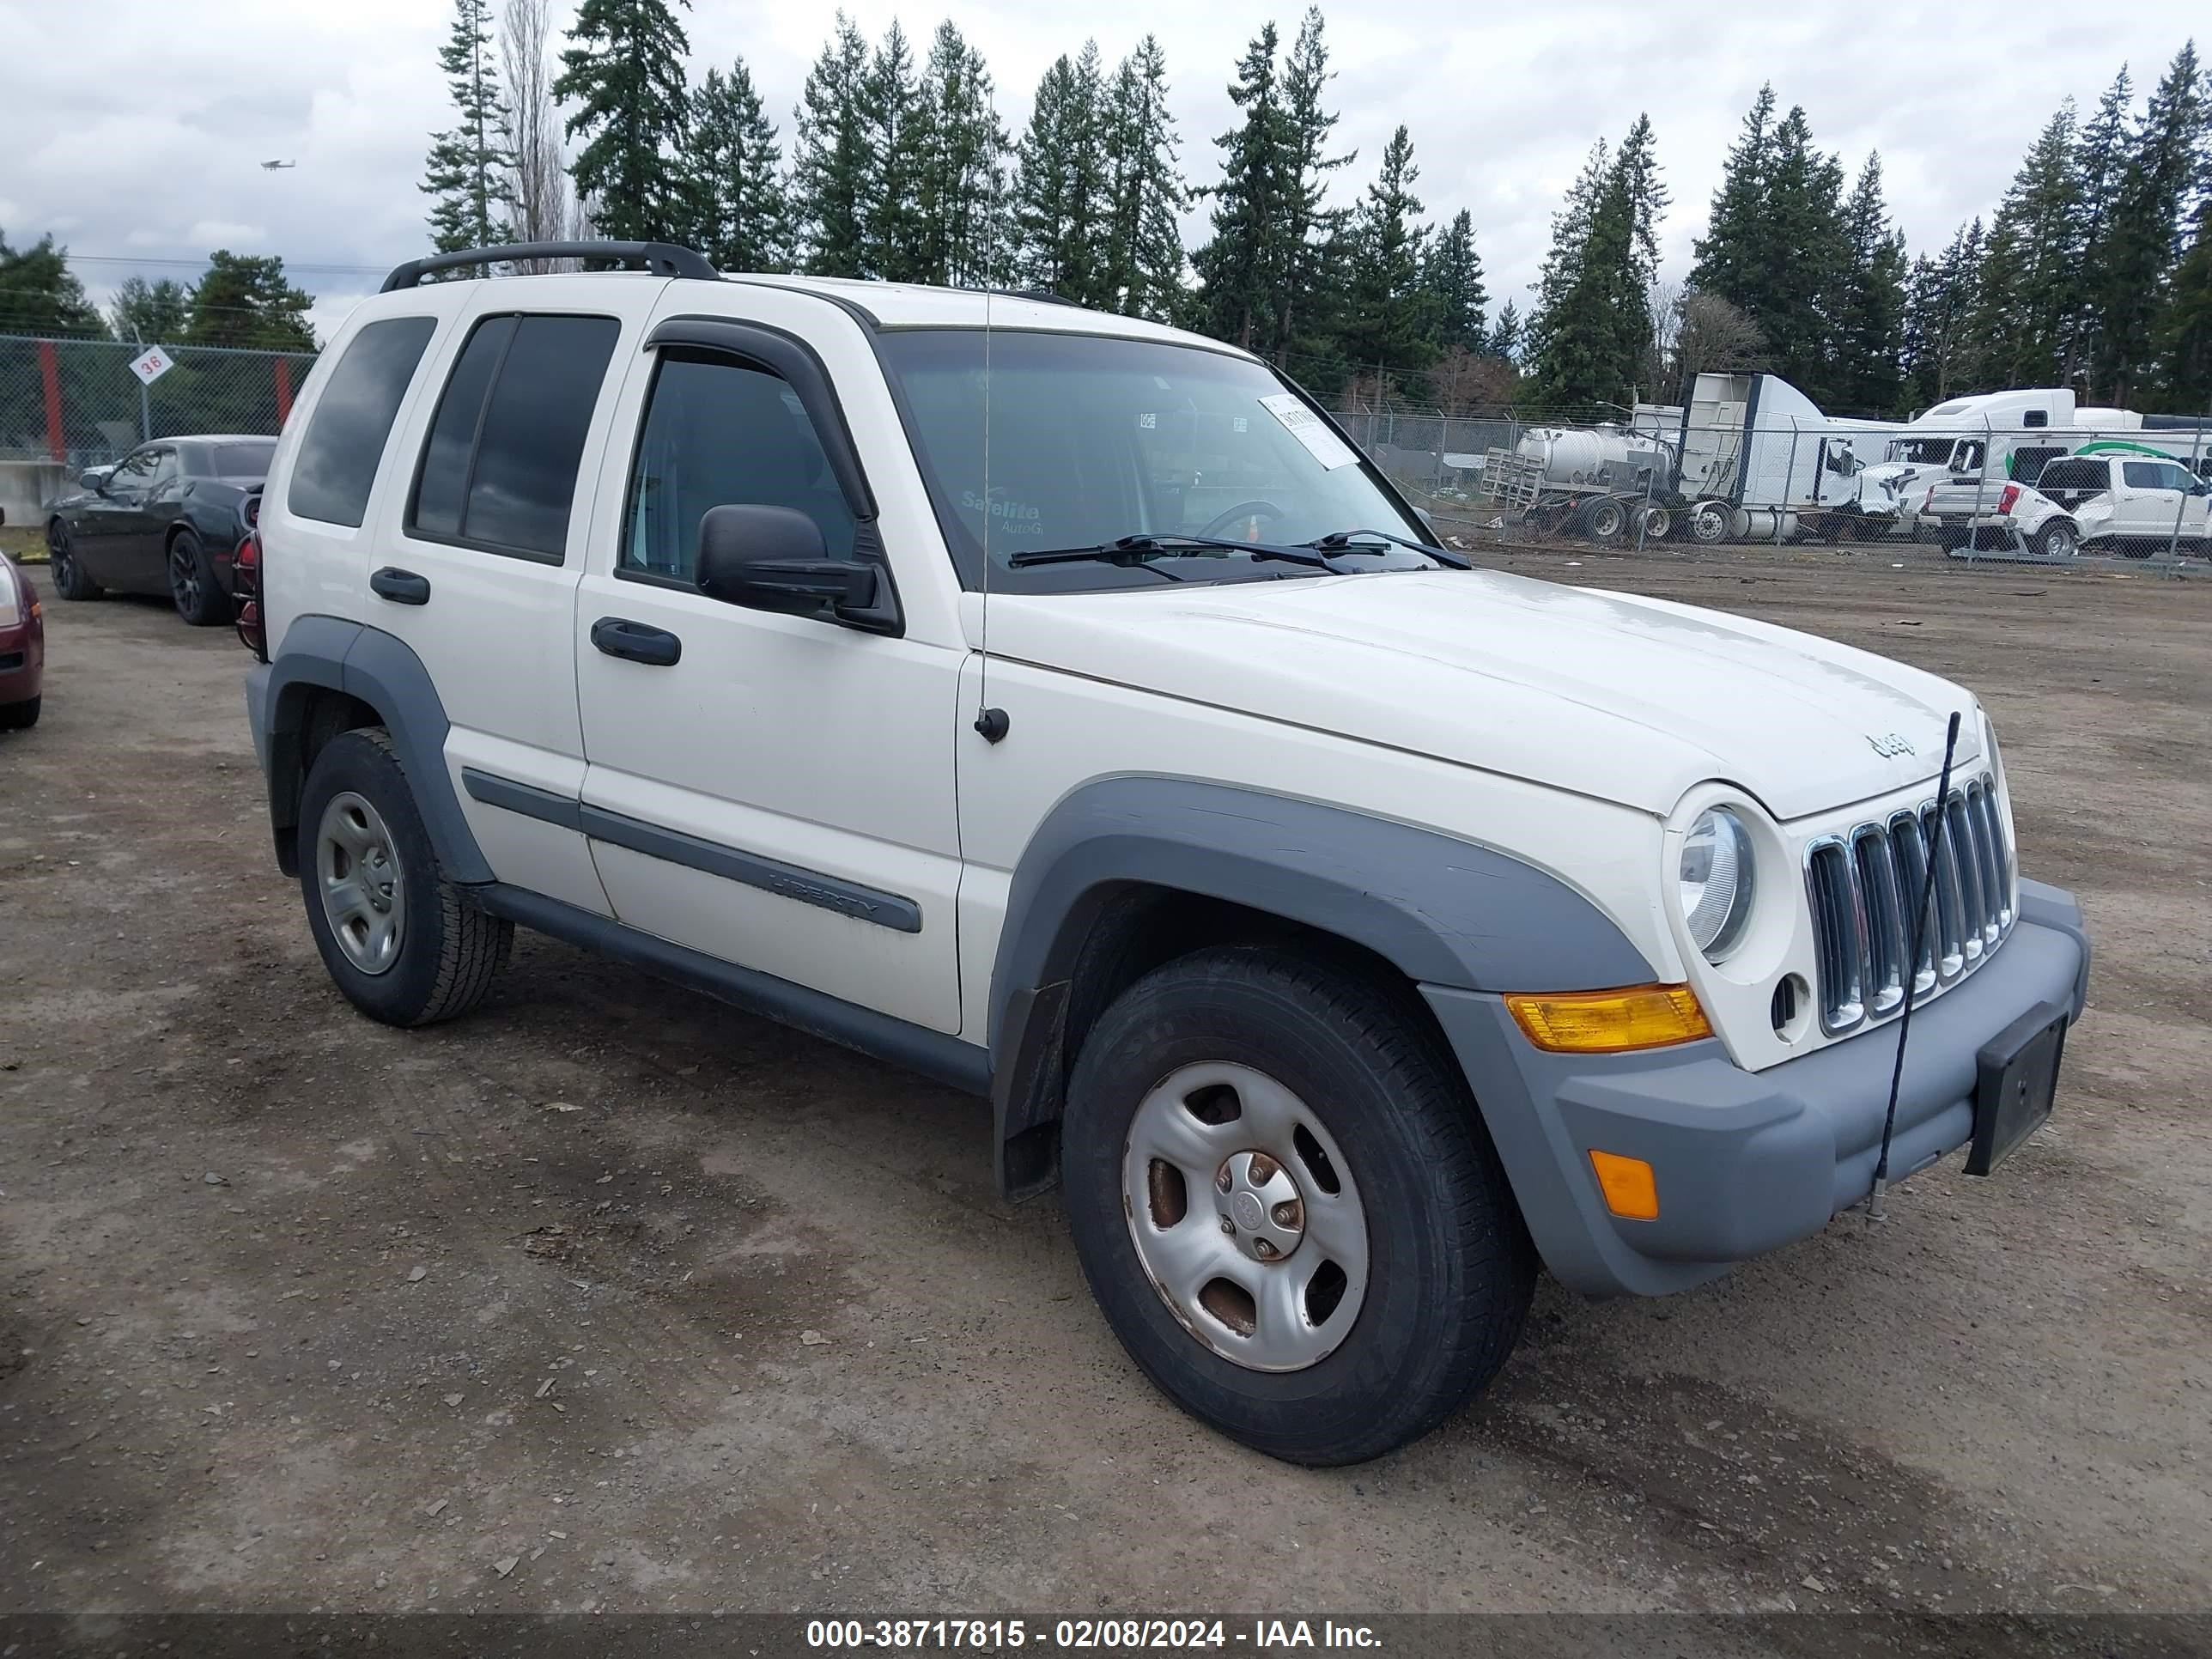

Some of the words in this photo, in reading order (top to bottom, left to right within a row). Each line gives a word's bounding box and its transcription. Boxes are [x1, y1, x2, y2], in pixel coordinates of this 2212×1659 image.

[141, 356, 161, 374] 36
[1864, 733, 1915, 760] Jeep
[769, 874, 878, 914] LIBERTY
